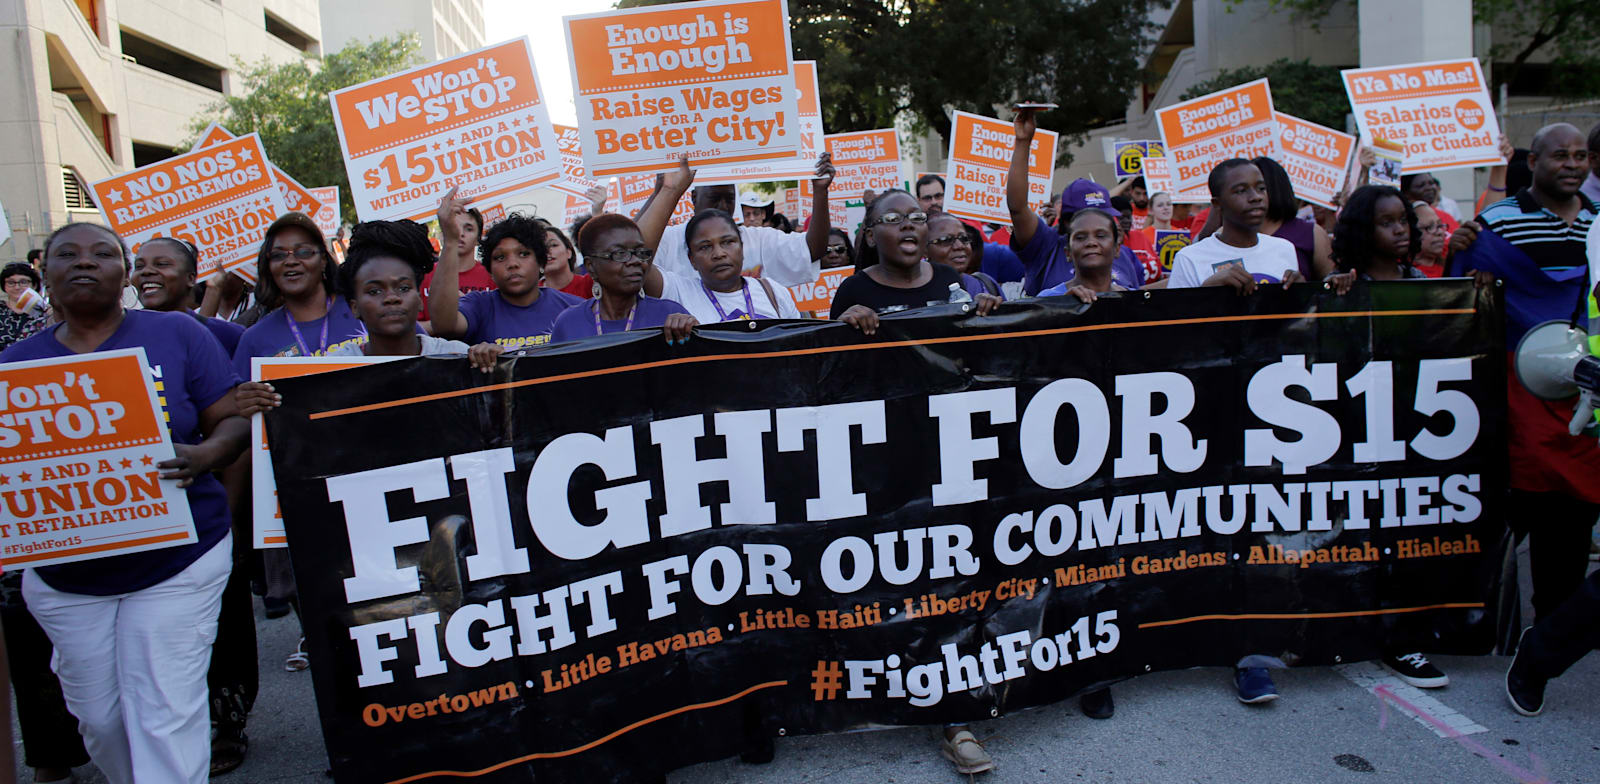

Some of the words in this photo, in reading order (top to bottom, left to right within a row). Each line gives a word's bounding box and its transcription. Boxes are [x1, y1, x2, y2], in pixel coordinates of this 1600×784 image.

[605, 14, 718, 47] Enough
[723, 12, 749, 36] is
[609, 36, 752, 76] Enough
[1389, 73, 1421, 91] No
[1422, 66, 1474, 88] Mas!
[355, 91, 420, 130] We
[411, 57, 499, 99] Won't
[423, 76, 516, 124] STOP
[590, 92, 675, 121] Raise
[681, 86, 783, 113] Wages
[661, 114, 689, 126] FOR
[693, 112, 704, 123] A
[1177, 96, 1235, 121] Enough
[1237, 93, 1251, 106] is
[1364, 103, 1452, 126] Salarios
[460, 125, 494, 144] AND
[497, 121, 509, 134] A
[594, 124, 697, 155] Better
[707, 111, 786, 147] City!
[1180, 105, 1254, 138] Enough
[1413, 120, 1457, 137] Altos
[831, 136, 873, 150] Enough
[874, 135, 885, 145] is
[971, 123, 1016, 148] Enoug
[1174, 142, 1217, 163] Raise
[1220, 126, 1272, 149] Wages
[1296, 124, 1337, 148] Won't
[1403, 140, 1427, 158] jor
[1432, 131, 1493, 155] Ciudad
[363, 144, 435, 193] $15
[434, 126, 542, 175] UNION
[834, 147, 886, 160] Enough
[1292, 137, 1341, 162] STOP
[125, 170, 172, 200] NO
[173, 149, 237, 185] NOS
[834, 167, 856, 178] aise
[858, 165, 897, 176] Wages
[955, 164, 996, 185] Raise
[1123, 156, 1141, 170] 15
[369, 182, 441, 211] WITHOUT
[445, 150, 546, 189] RETALIATION
[829, 181, 866, 193] Better
[868, 175, 899, 191] City!
[1287, 164, 1337, 189] UNION
[112, 164, 263, 225] RENDIREMOS
[953, 184, 1003, 208] Better
[191, 218, 201, 229] Y
[203, 207, 238, 225] UNA
[791, 282, 828, 303] We
[41, 462, 91, 481] AND
[97, 459, 115, 473] A
[326, 400, 887, 603] FIGHT
[928, 371, 1207, 507] FOR
[1244, 354, 1480, 475] $15
[1, 471, 164, 519] UNION
[18, 501, 170, 537] RETALIATION
[4, 535, 83, 555] #FightFor15
[348, 571, 623, 688] FIGHT
[642, 543, 800, 620] FOR
[820, 524, 979, 593] OUR
[993, 474, 1482, 566] COMMUNITIES
[362, 680, 518, 727] Overtown
[541, 652, 612, 694] Little
[617, 625, 722, 667] Havana
[740, 604, 810, 634] Little
[817, 602, 882, 630] Haiti
[904, 585, 990, 620] Liberty
[995, 576, 1037, 605] City
[1055, 560, 1126, 589] Miami
[1131, 547, 1227, 577] Gardens
[1246, 541, 1379, 569] Allapattah
[1397, 535, 1481, 559] Hialeah
[811, 610, 1120, 706] #FightFor15
